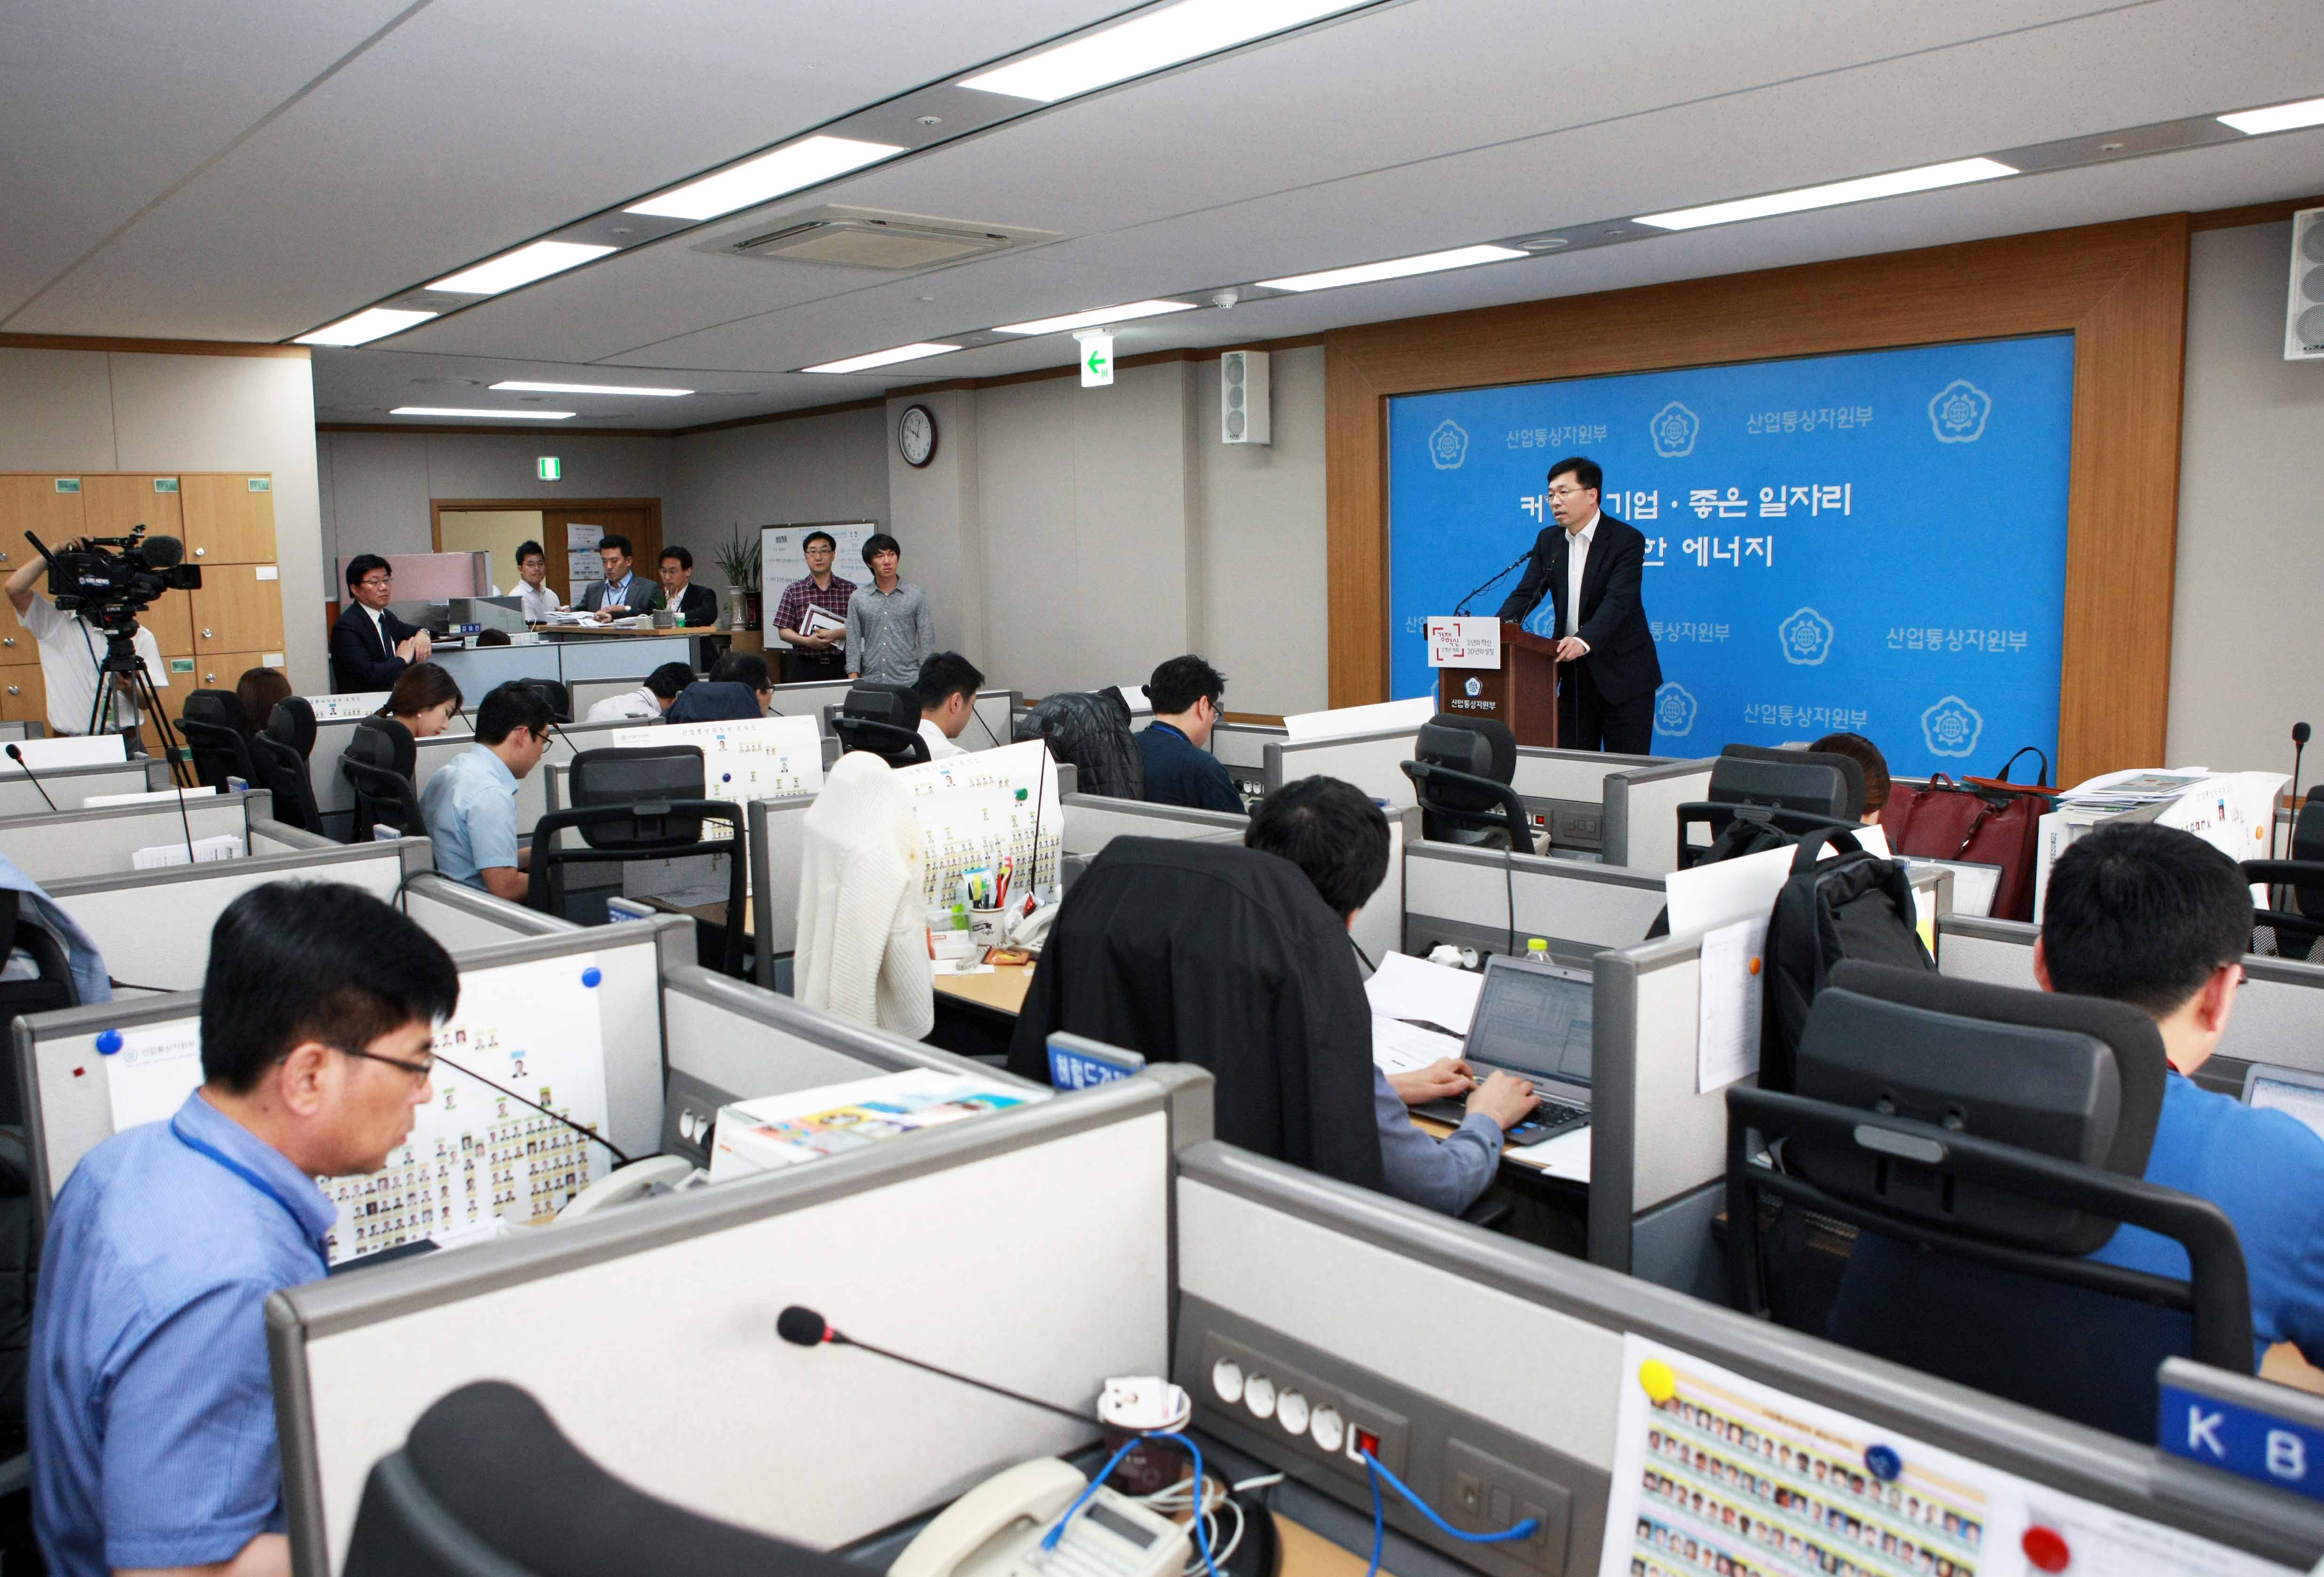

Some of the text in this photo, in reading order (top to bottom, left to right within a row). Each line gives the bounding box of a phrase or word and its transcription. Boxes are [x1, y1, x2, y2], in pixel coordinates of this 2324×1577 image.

[1747, 406, 1874, 434] 산업통상자원부
[1507, 424, 1608, 449] 산업통상자원부
[1606, 491, 1658, 520] 기업
[1689, 487, 1748, 519] 좋은
[1759, 483, 1852, 518] 일자리
[1682, 535, 1774, 567] 에너지
[1650, 621, 1730, 643] 통상자원부
[1886, 627, 2028, 653] 산업통상자원부
[1451, 699, 1496, 710] 산업통상자원부
[1743, 703, 1868, 731] 산업통상자원부
